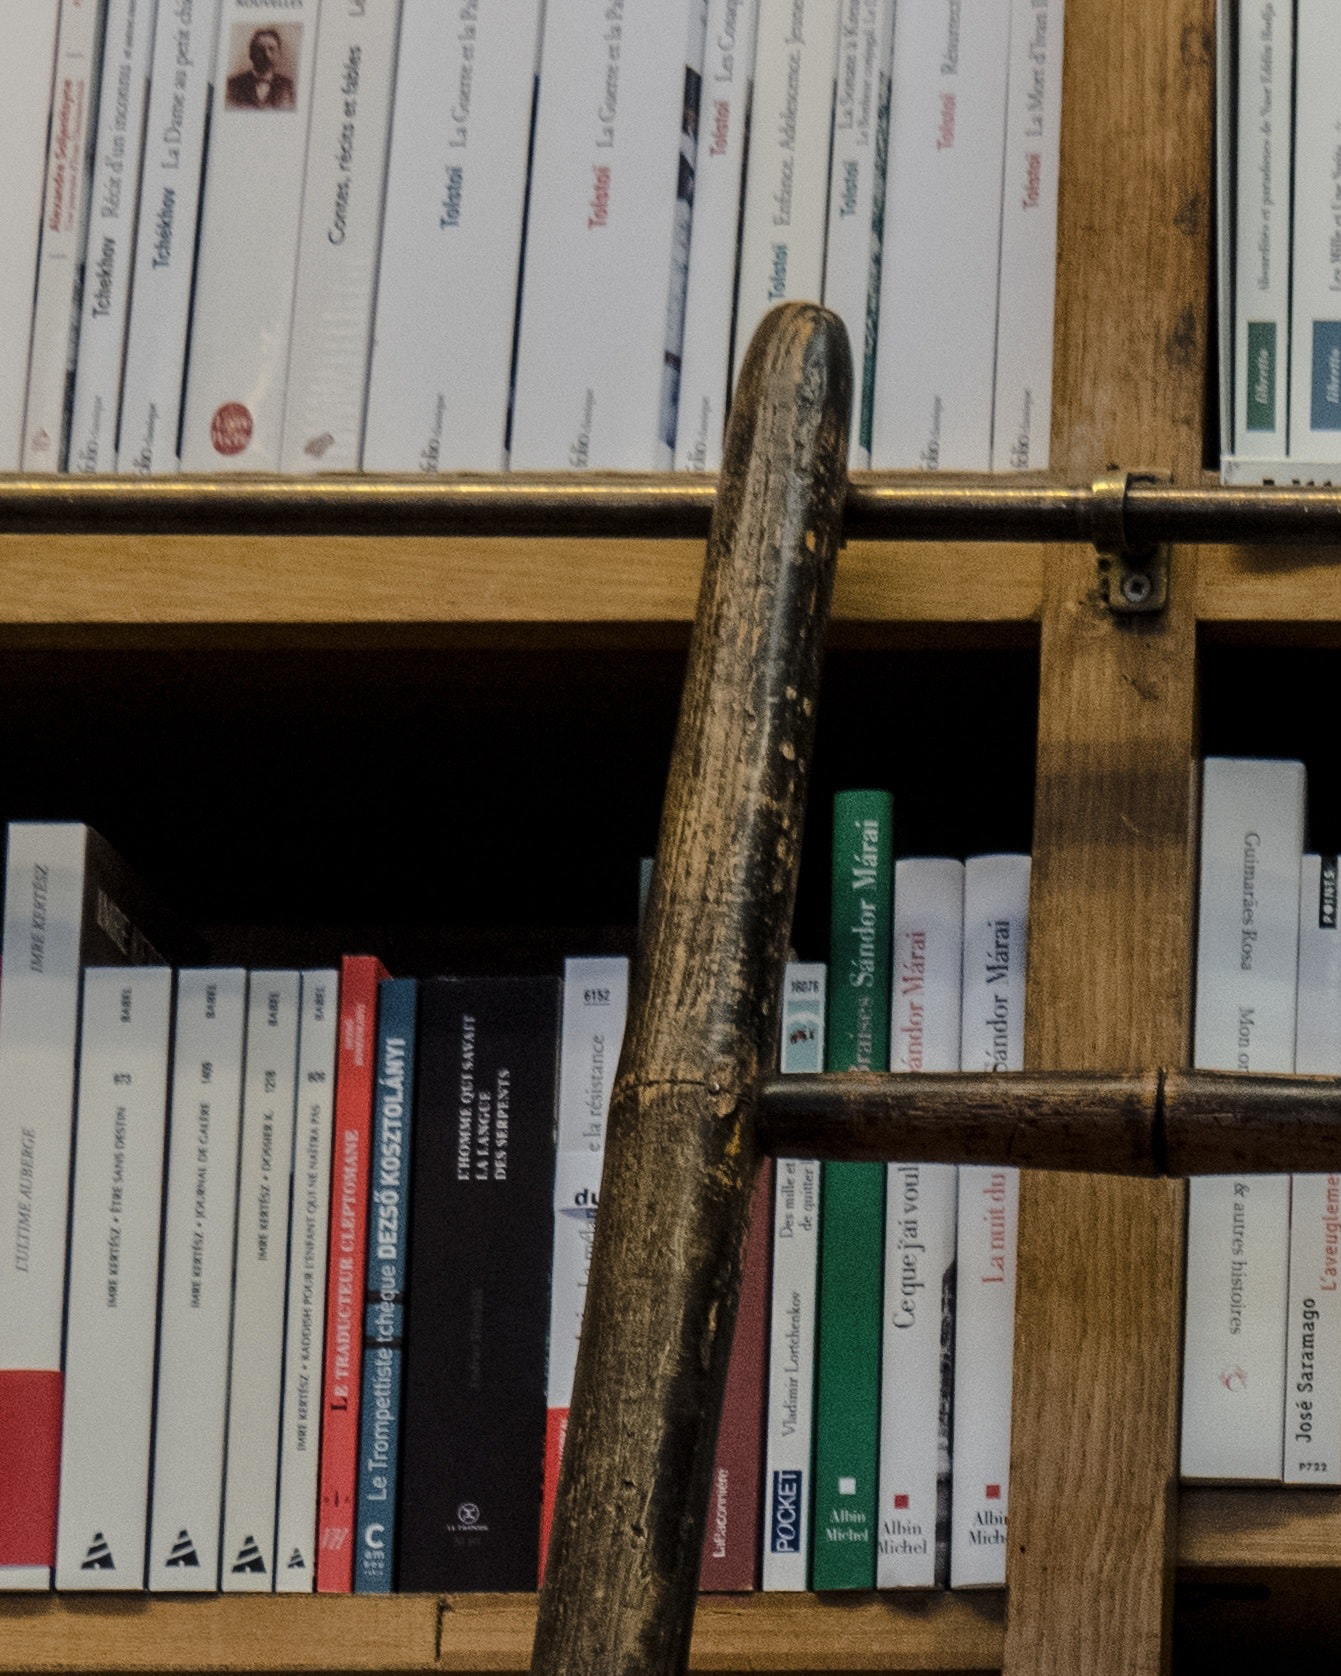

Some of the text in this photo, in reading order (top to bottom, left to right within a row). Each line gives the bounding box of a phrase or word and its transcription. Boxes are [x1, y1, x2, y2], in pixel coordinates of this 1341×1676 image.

[850, 819, 879, 987] Sándor Márai
[374, 1189, 399, 1259] DEZSŐ
[371, 1265, 398, 1343] tchèque
[369, 1348, 398, 1470] Trompettiste
[367, 1476, 387, 1501] Le
[771, 1470, 802, 1552] POCKET
